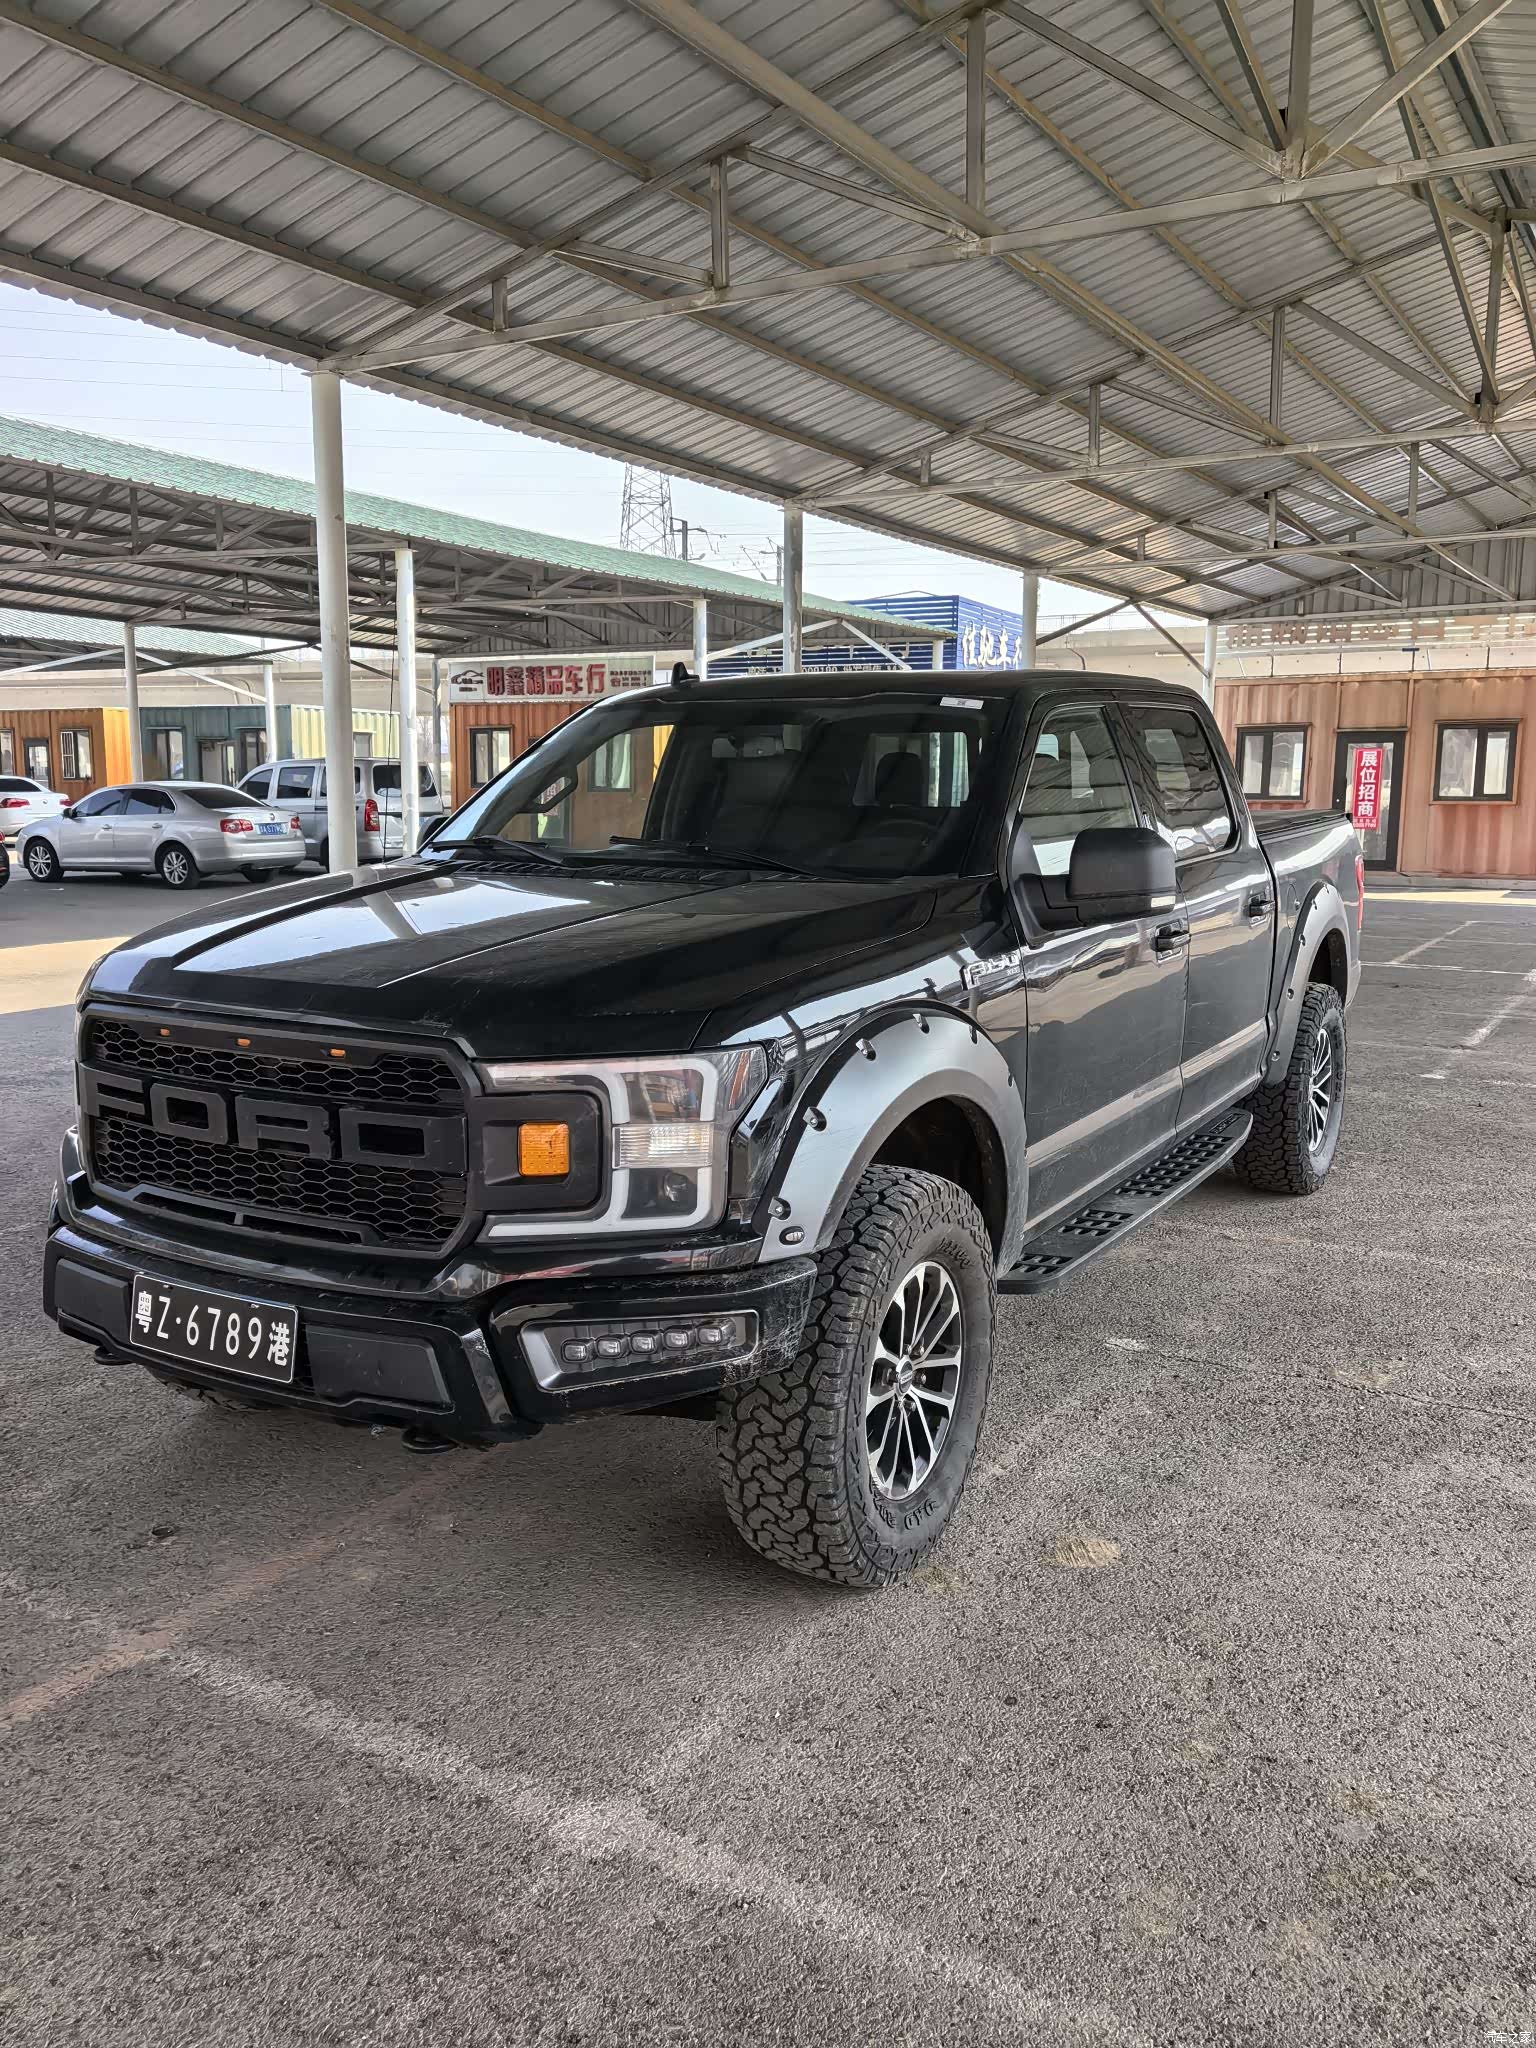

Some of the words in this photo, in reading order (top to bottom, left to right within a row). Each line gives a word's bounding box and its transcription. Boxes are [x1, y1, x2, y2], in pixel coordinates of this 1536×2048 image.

[1357, 751, 1378, 817] 展位招商
[80, 1065, 468, 1176] FORD
